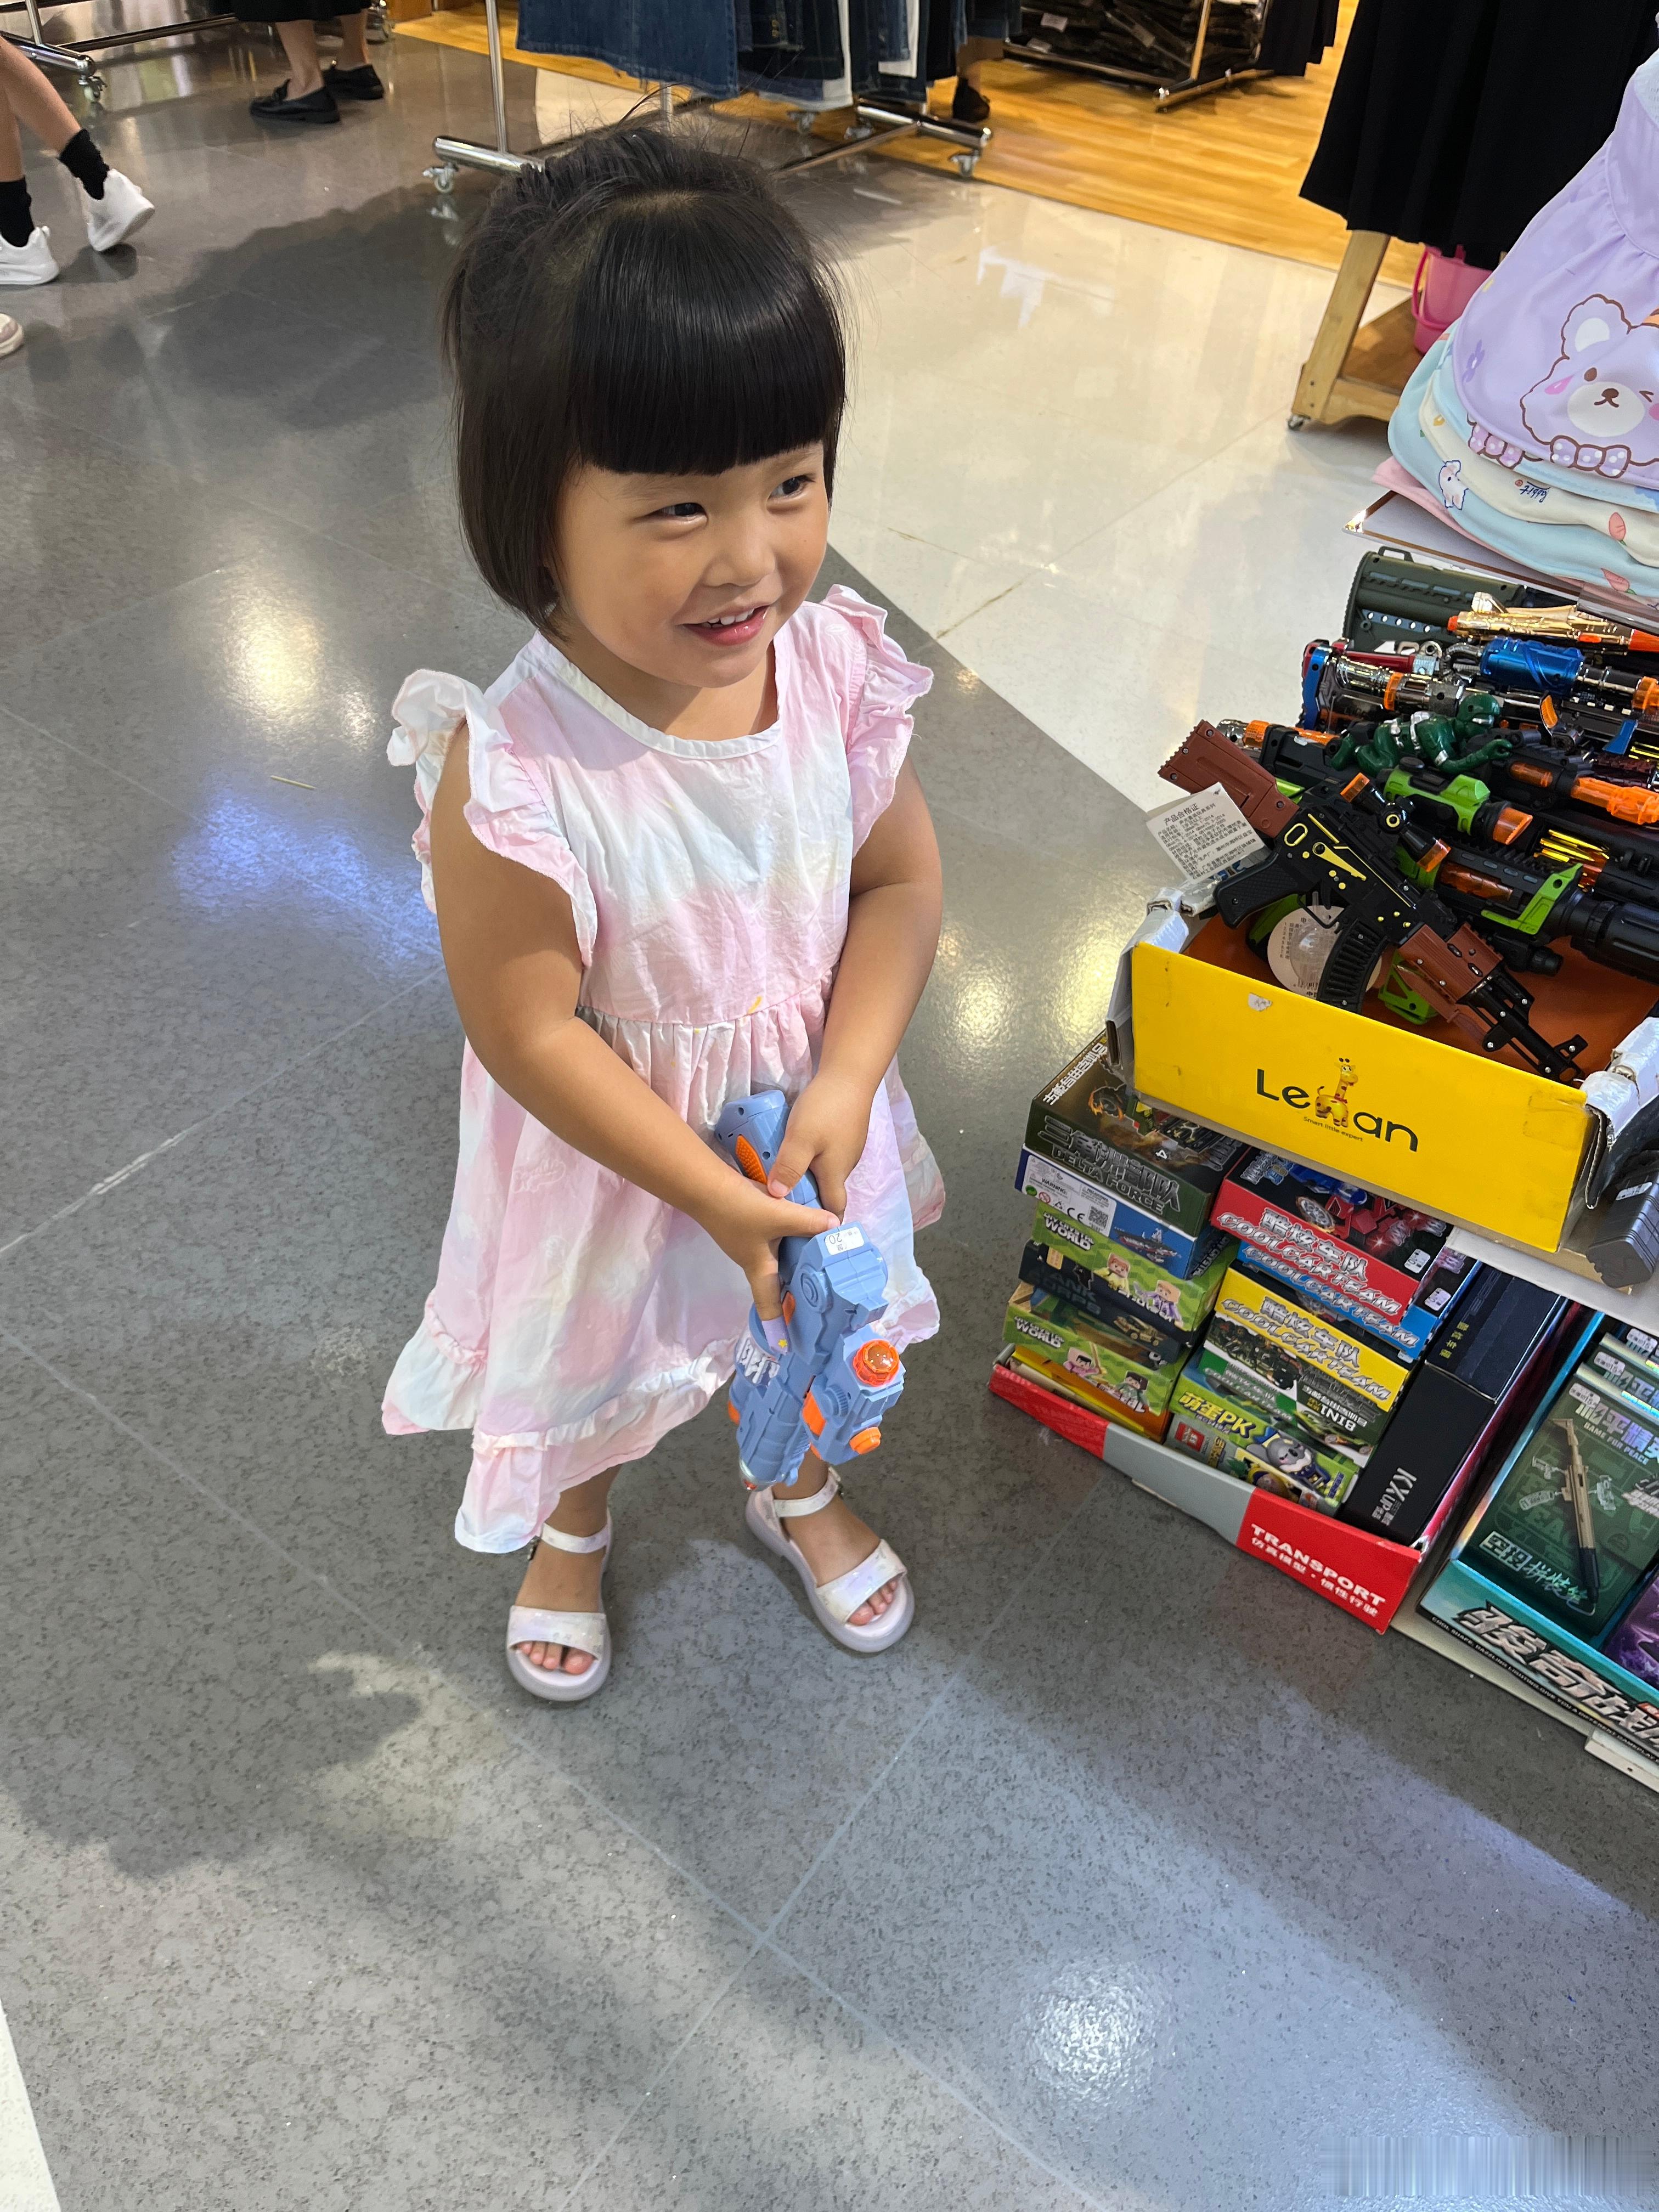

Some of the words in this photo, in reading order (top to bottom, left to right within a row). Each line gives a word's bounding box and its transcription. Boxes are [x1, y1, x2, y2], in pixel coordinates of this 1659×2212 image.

[1164, 803, 1199, 826] 产品合格证
[1302, 1116, 1323, 1127] Smart
[1324, 1124, 1340, 1133] little
[1341, 1131, 1363, 1142] expert
[1051, 1143, 1107, 1183] DELTA
[1105, 1173, 1166, 1215] FORCE
[1046, 1218, 1092, 1251] WORLD
[1258, 1206, 1368, 1283] 酷炫车队
[1017, 1319, 1062, 1348] WORLD
[1259, 1296, 1361, 1369] 酷炫车队
[1583, 1421, 1606, 1439] GAME
[1606, 1435, 1623, 1449] FOR
[1623, 1446, 1649, 1465] PEACE
[1385, 1466, 1418, 1502] KX
[1251, 1524, 1386, 1606] TRANSPORT
[1481, 1532, 1529, 1568] 空投
[1431, 1616, 1451, 1630] COOL
[1557, 1698, 1571, 1709] YOU
